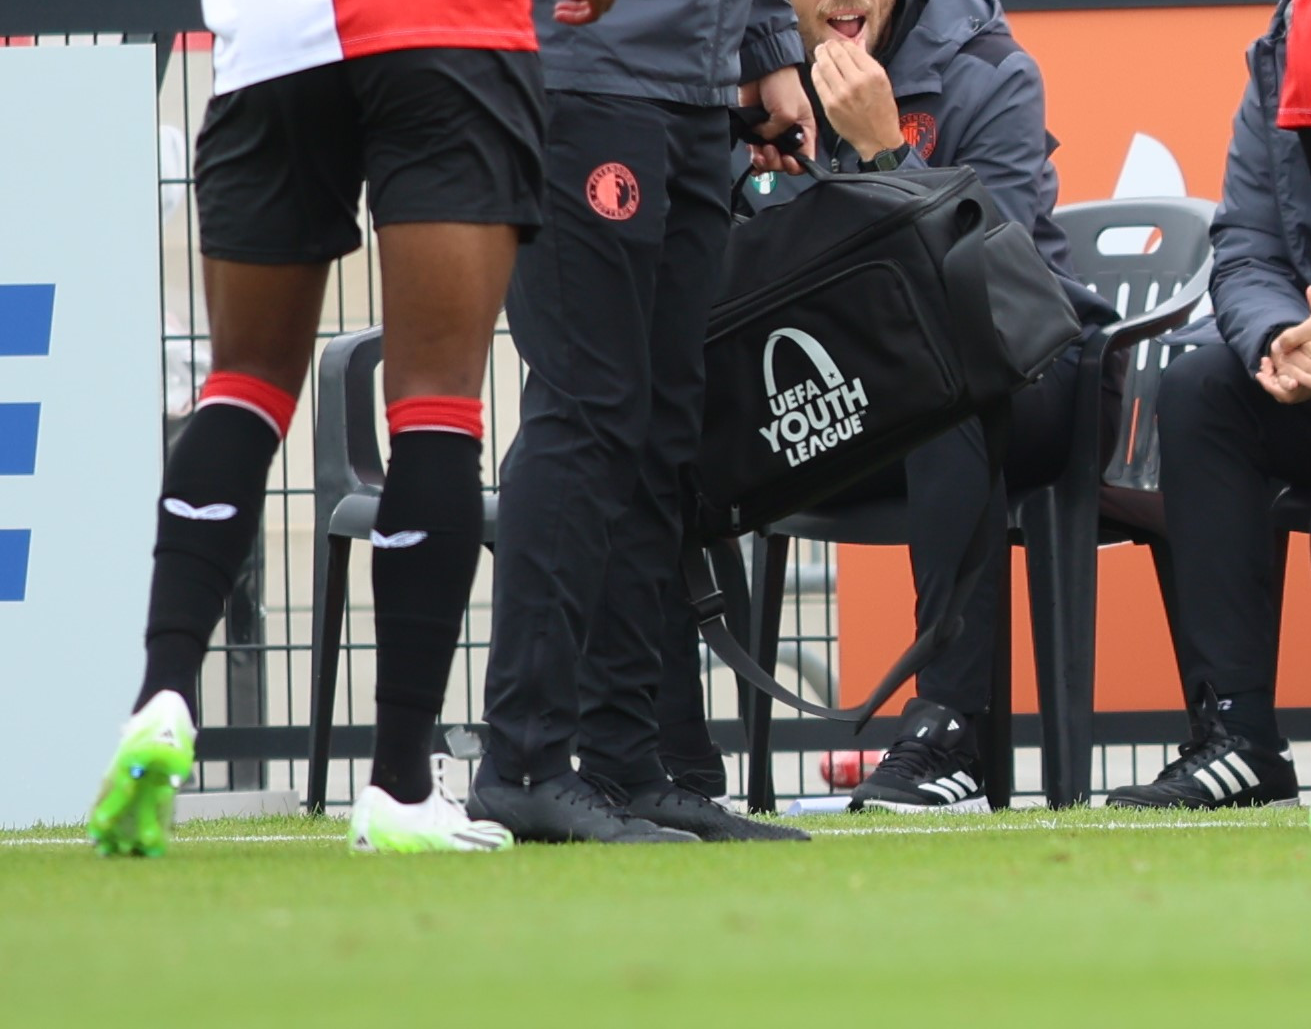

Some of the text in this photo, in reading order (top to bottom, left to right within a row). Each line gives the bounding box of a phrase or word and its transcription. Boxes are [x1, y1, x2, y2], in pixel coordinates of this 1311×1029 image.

[759, 377, 869, 453] YOUTH
[769, 378, 821, 416] UEFA
[785, 413, 864, 467] LEAGUE
